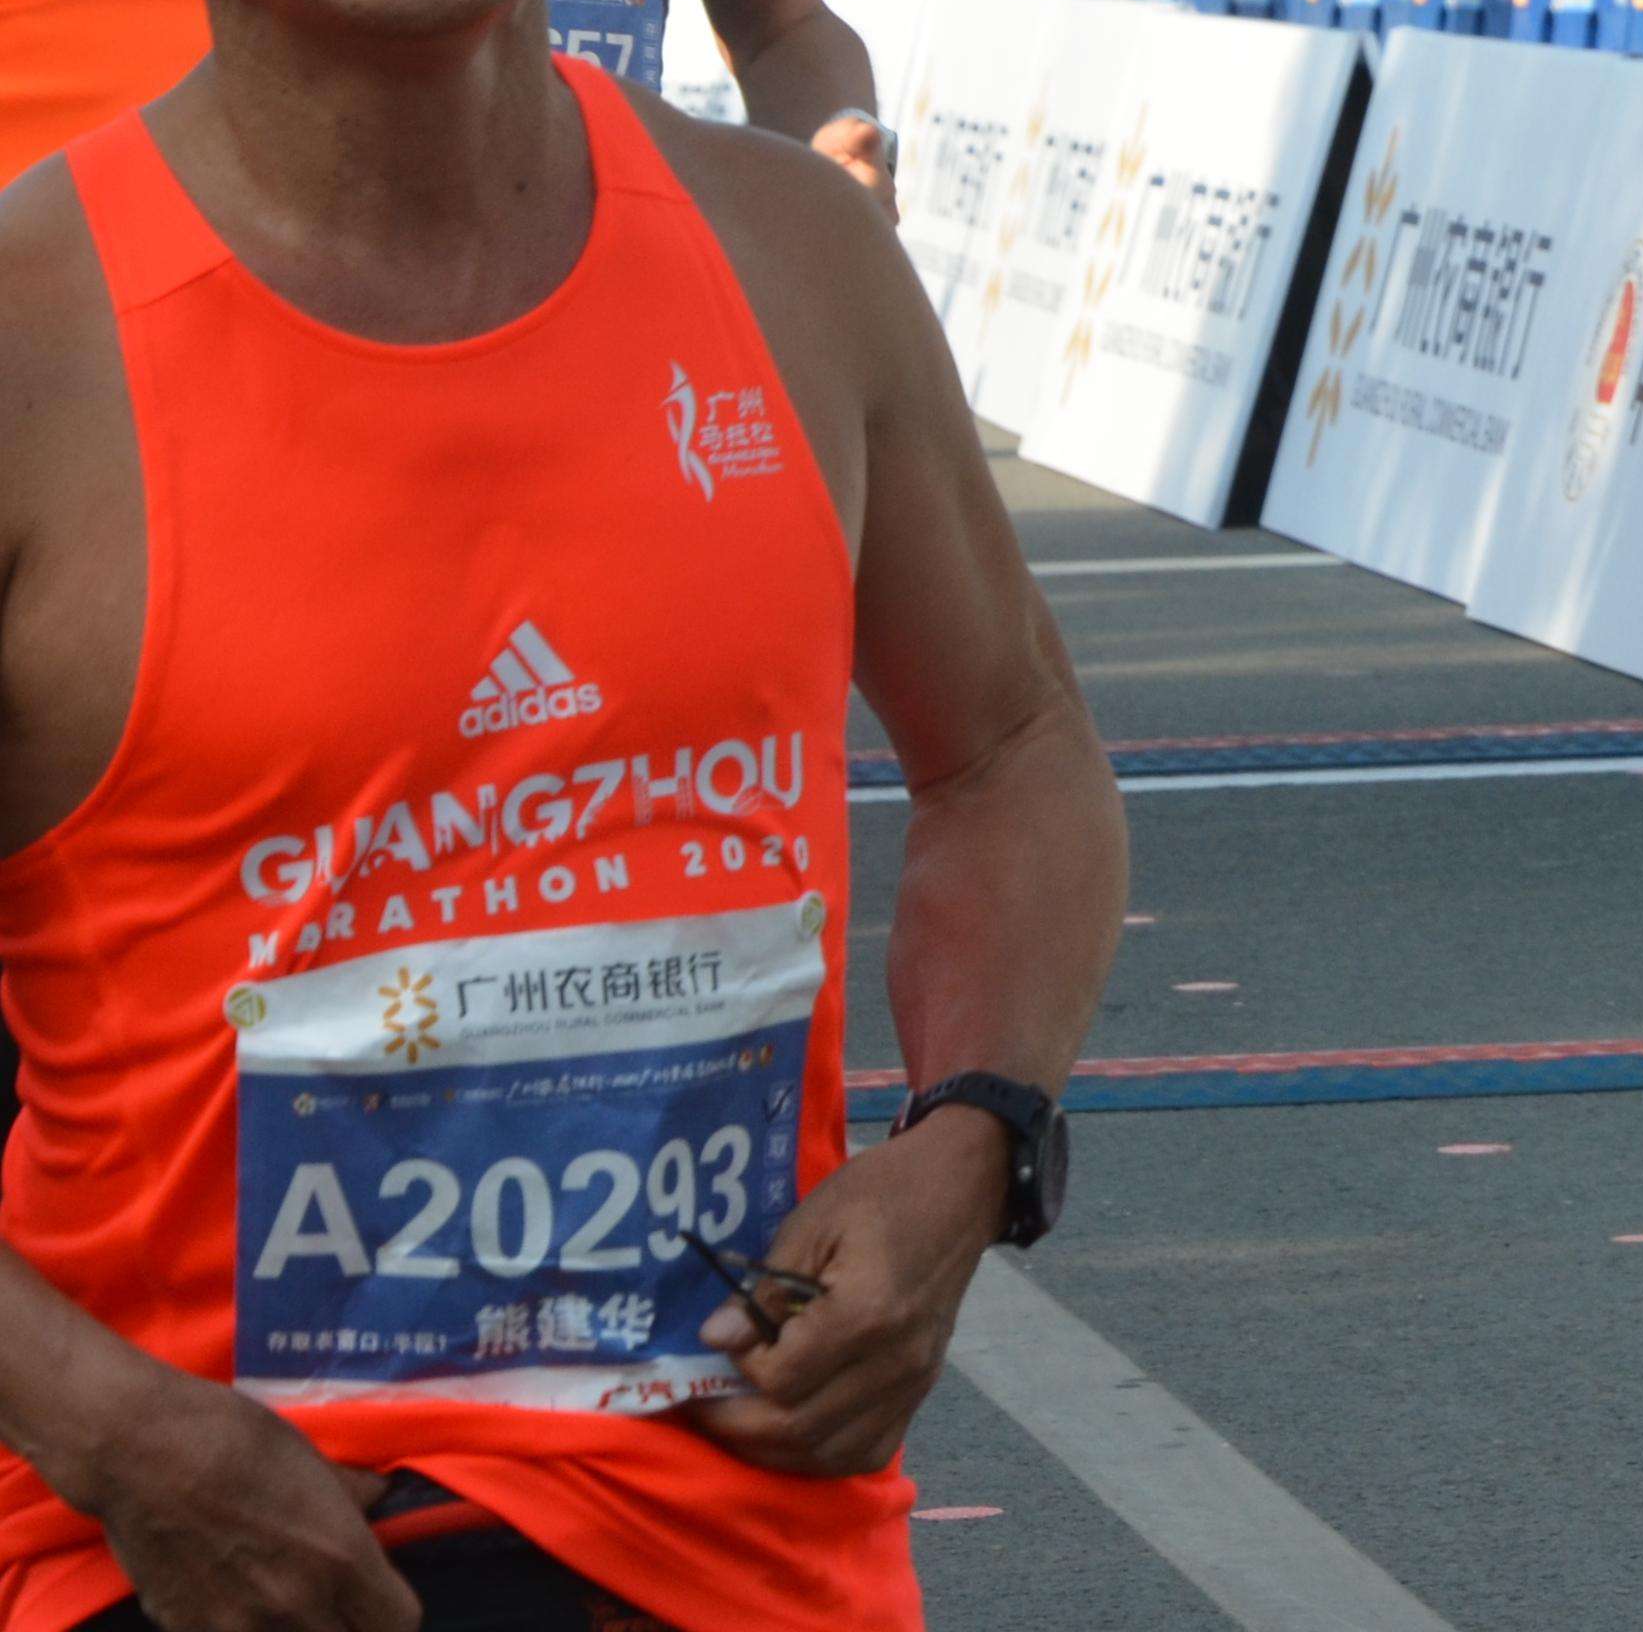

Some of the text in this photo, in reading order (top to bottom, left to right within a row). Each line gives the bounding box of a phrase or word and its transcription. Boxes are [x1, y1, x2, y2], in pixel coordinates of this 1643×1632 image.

[1371, 202, 1552, 381] 广州农商银行
[459, 681, 603, 738] adidas
[241, 731, 802, 906] GUANGZHOU
[249, 835, 810, 970] MARATHON 2020
[457, 951, 724, 1018] 广州农商银行
[254, 1125, 753, 1279] A20293
[472, 1293, 656, 1360] 熊建华
